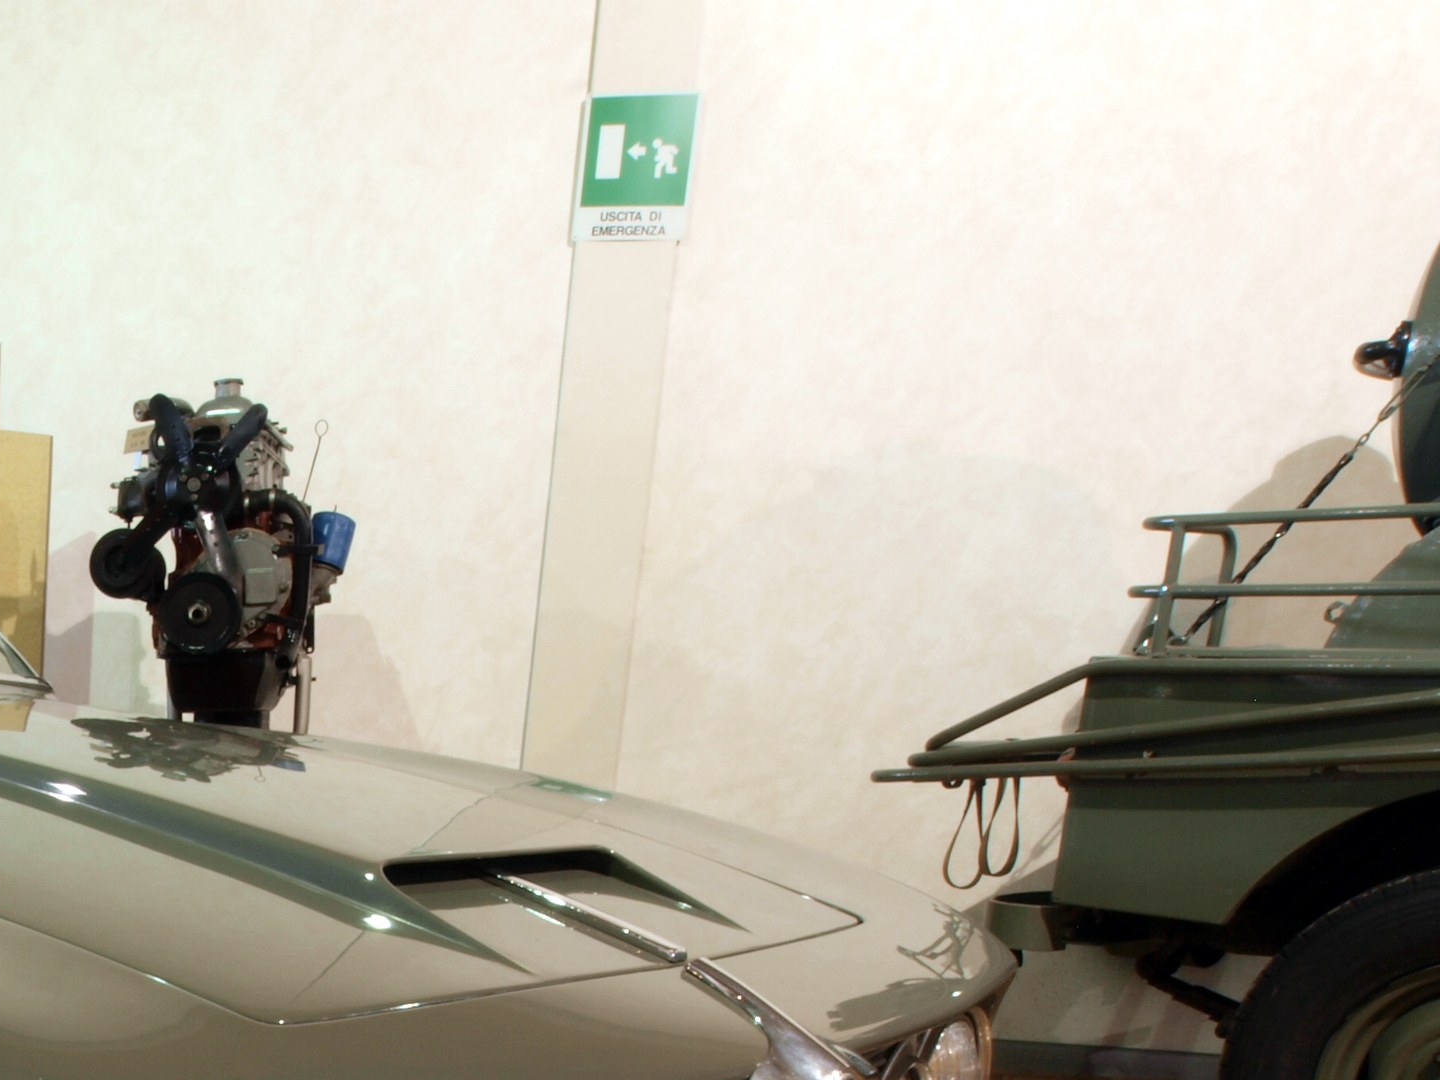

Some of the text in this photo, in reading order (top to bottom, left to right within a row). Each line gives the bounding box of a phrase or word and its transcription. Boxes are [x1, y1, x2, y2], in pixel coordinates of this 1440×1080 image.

[599, 211, 662, 222] USCITA DI
[591, 225, 666, 237] EMERGENZA
